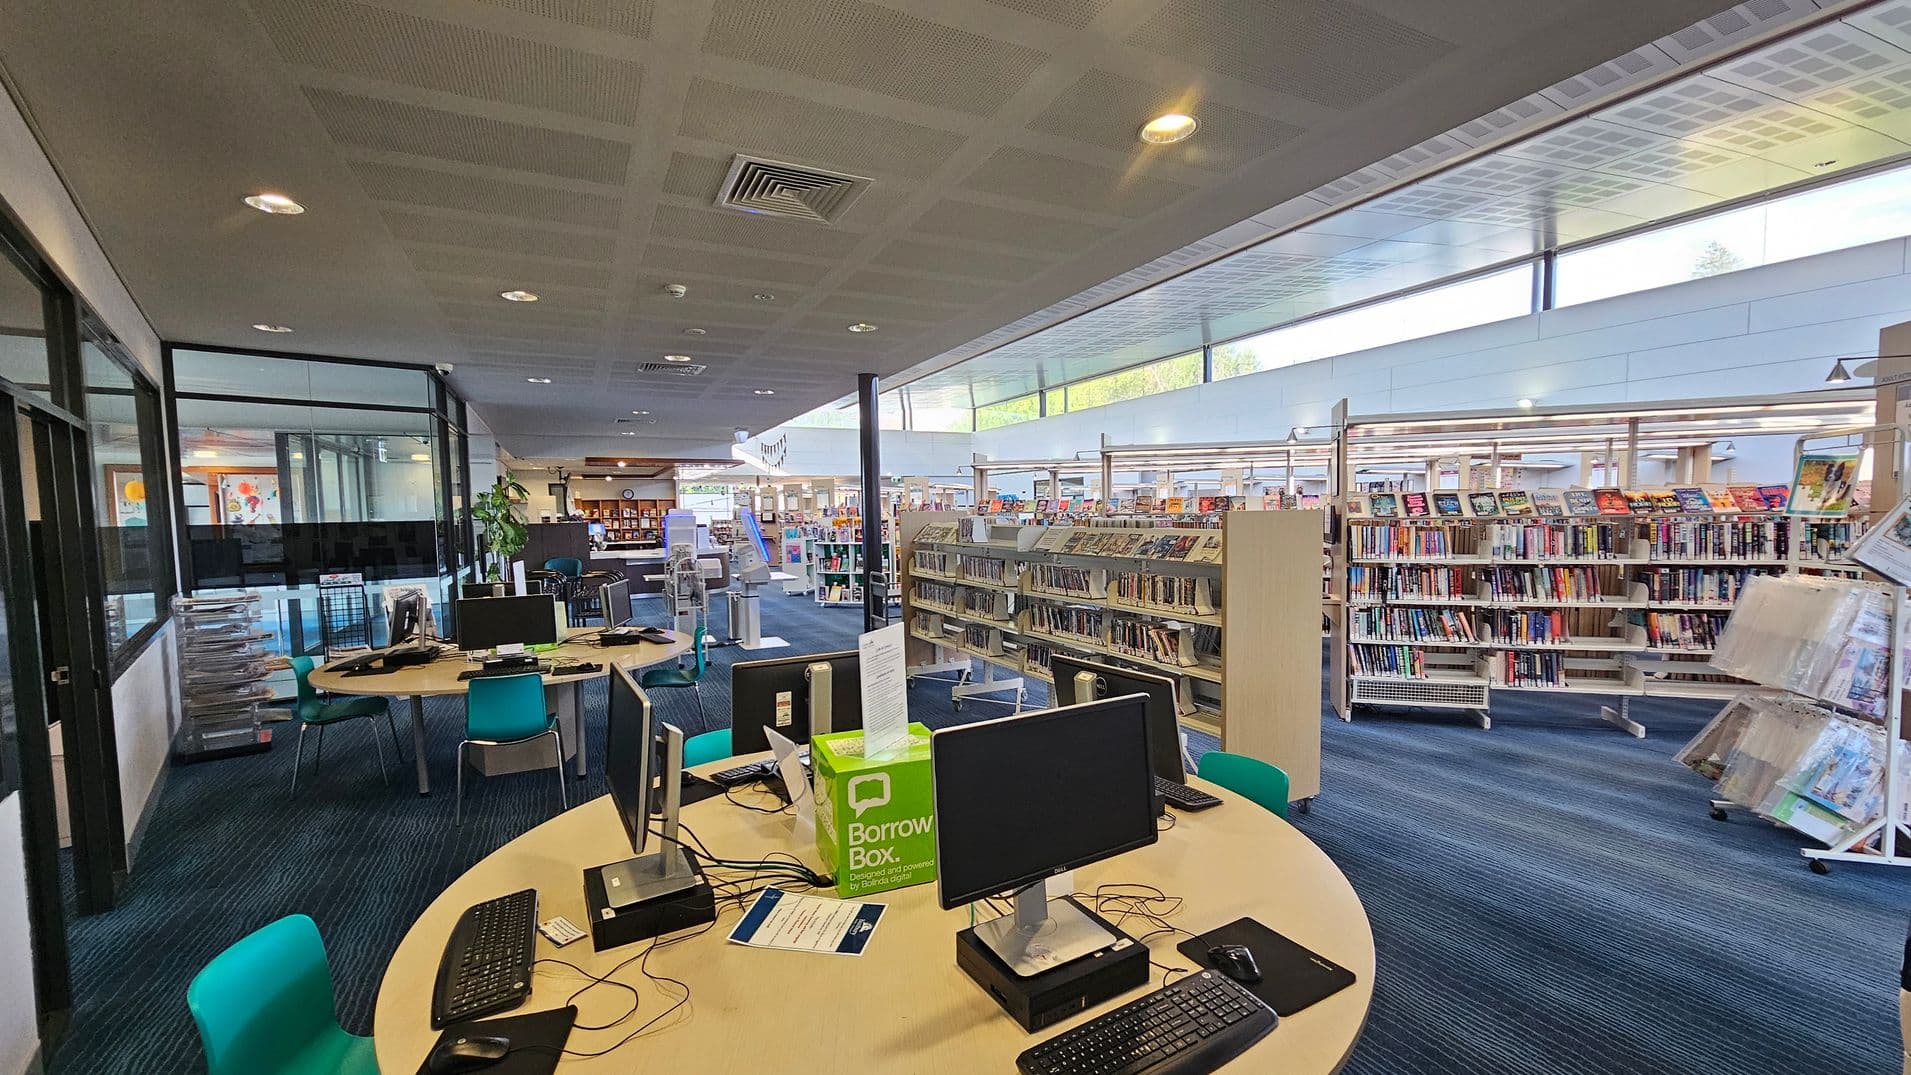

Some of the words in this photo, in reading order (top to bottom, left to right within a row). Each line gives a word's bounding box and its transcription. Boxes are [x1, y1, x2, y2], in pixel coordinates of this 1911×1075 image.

[848, 815, 933, 846] Borrow
[849, 846, 900, 870] Box.
[850, 868, 886, 881] Designed
[887, 865, 902, 875] and
[903, 859, 934, 872] powered
[850, 882, 860, 891] by
[861, 877, 889, 888] Bolinda
[890, 872, 912, 883] digital
